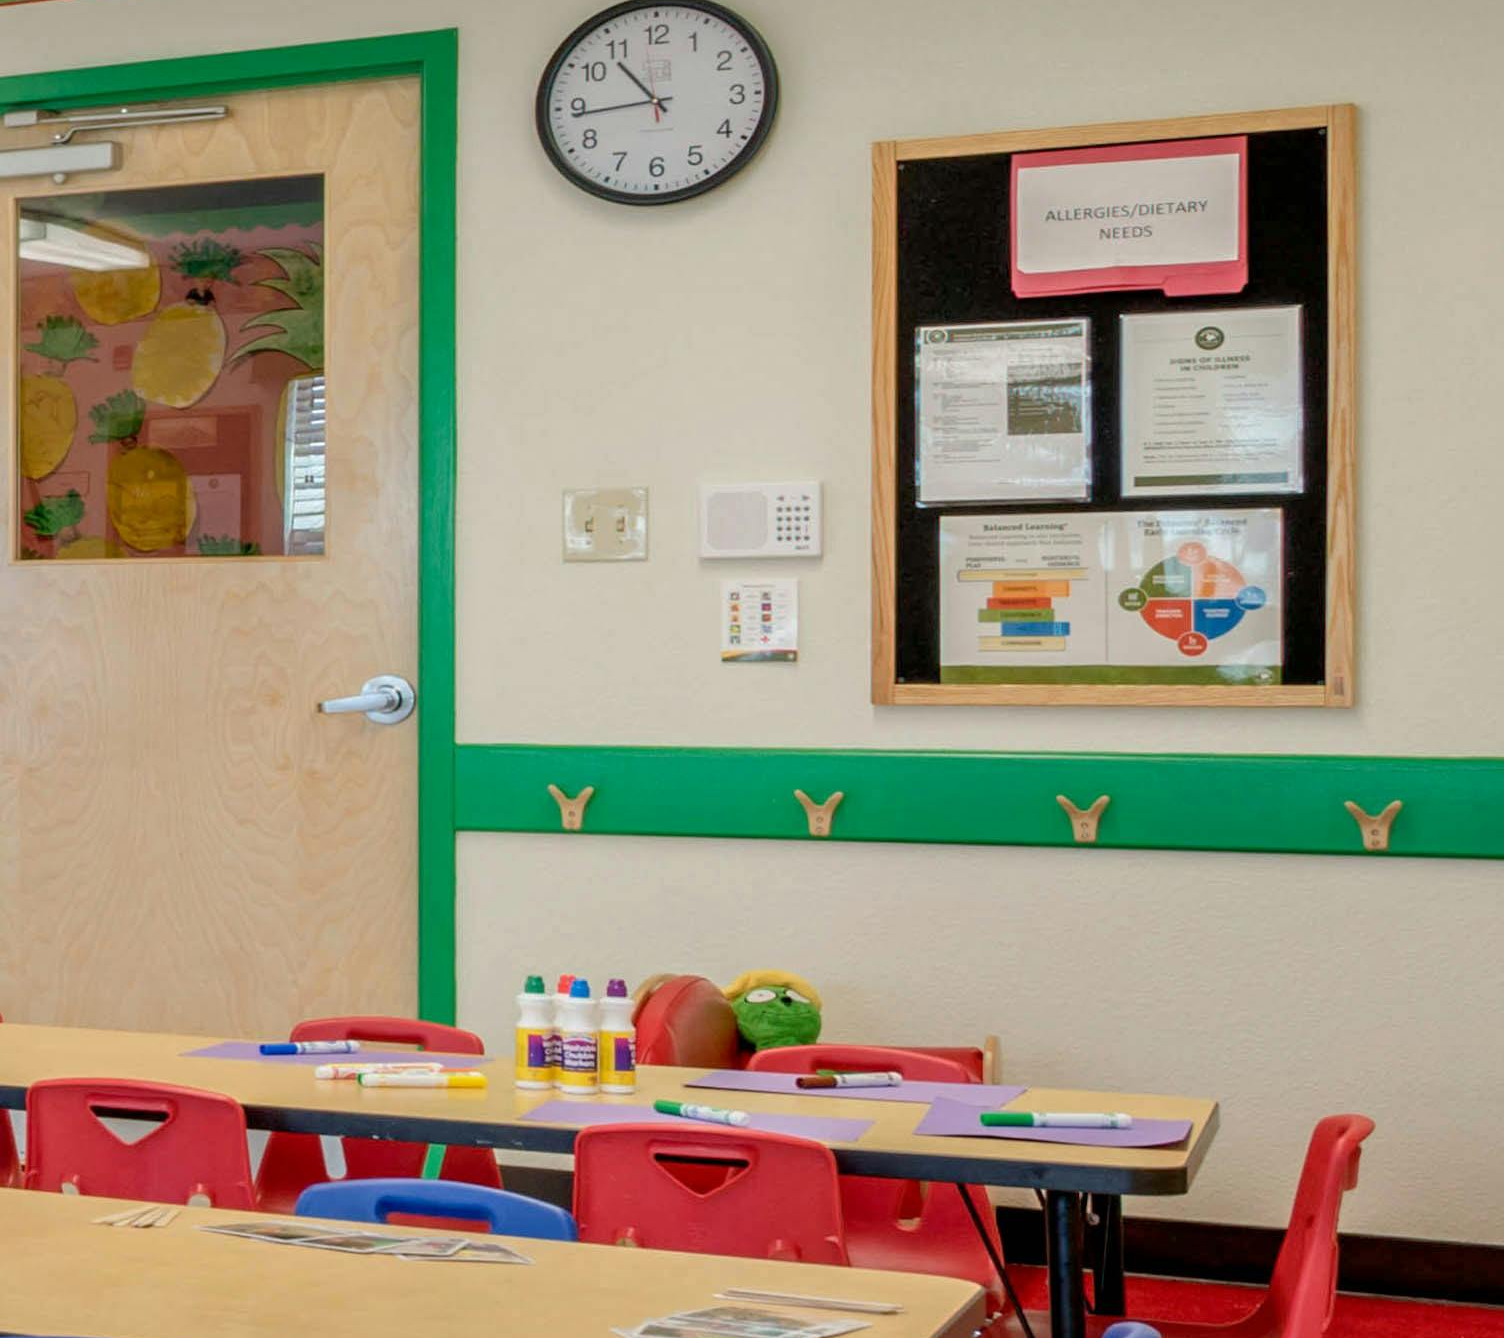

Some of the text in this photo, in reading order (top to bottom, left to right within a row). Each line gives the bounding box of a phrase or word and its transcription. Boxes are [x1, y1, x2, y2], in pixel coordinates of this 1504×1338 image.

[645, 24, 670, 45] 12
[689, 32, 697, 52] 1
[605, 39, 628, 59] 11
[716, 50, 732, 71] 2
[582, 61, 606, 82] 10
[729, 84, 746, 105] 3
[571, 98, 586, 118] 9
[716, 119, 733, 138] 4
[582, 129, 598, 149] 8
[613, 152, 628, 172] 7
[688, 145, 703, 166] 5
[649, 156, 665, 177] 6
[1045, 199, 1208, 222] ALLERGIES/DIETARY
[1099, 225, 1153, 240] NEEDS
